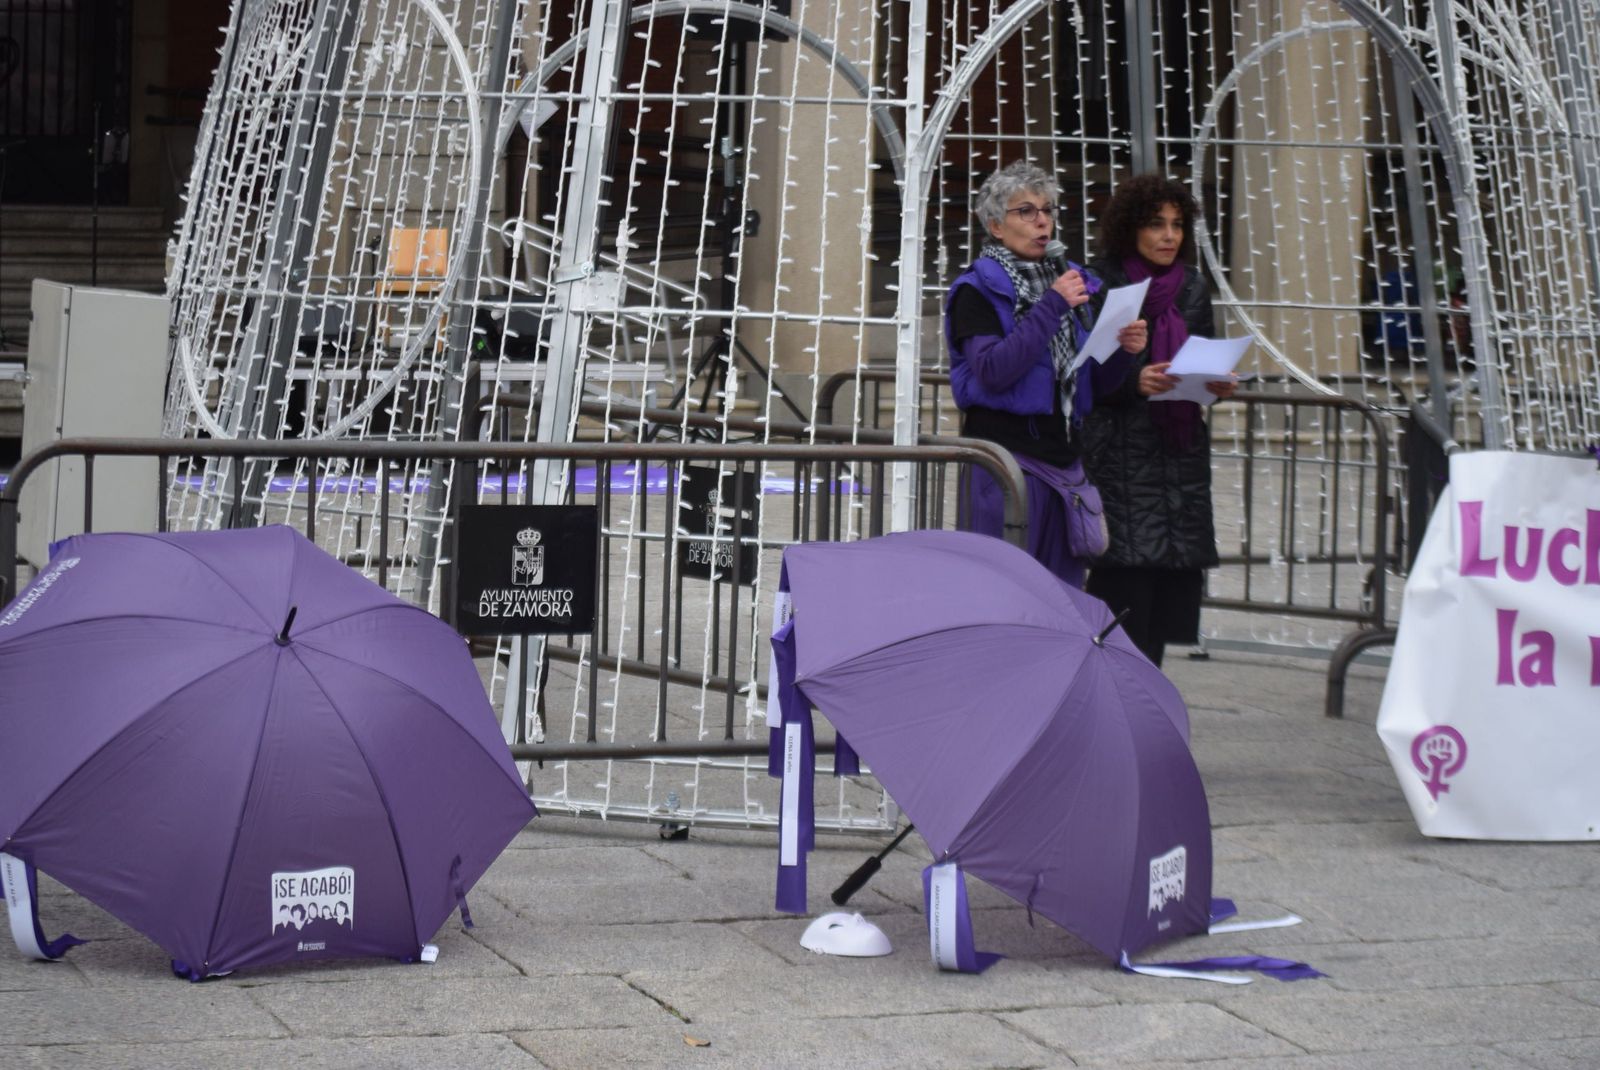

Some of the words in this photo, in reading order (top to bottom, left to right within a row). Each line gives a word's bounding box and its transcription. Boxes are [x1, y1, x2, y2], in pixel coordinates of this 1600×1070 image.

[688, 549, 700, 563] DE
[701, 551, 734, 568] ZAMOR
[480, 589, 574, 602] AYUNTAMIENTO
[479, 601, 499, 617] DE
[502, 601, 572, 617] ZAMORA
[1496, 607, 1557, 688] la
[274, 878, 296, 899] ¡SE
[300, 871, 352, 897] ACABÓ!
